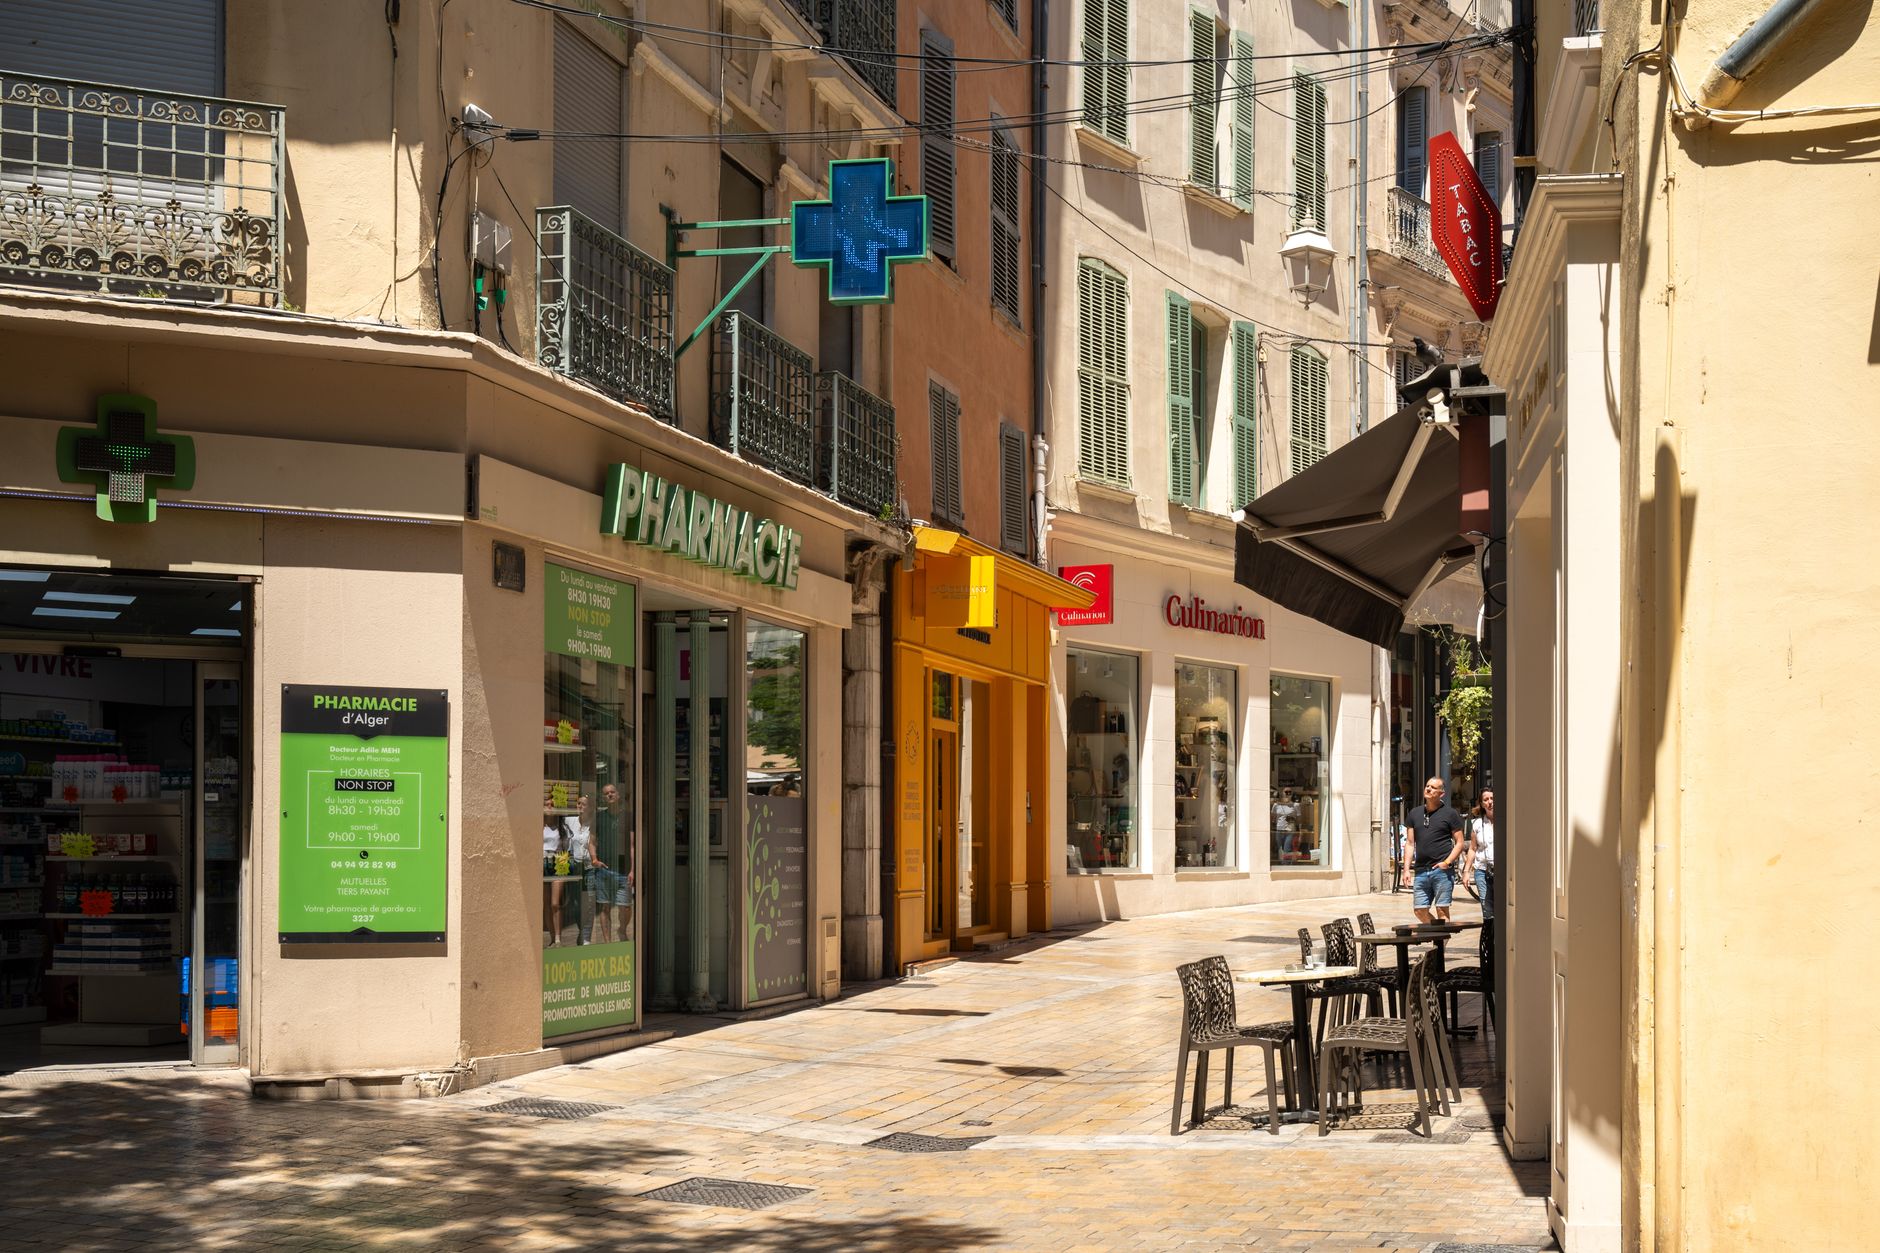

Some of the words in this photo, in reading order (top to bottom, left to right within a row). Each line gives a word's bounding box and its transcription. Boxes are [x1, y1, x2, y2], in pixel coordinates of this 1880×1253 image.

[1448, 183, 1482, 267] TABAC
[601, 462, 804, 591] PHARMACIE
[560, 570, 569, 584] Du
[570, 572, 585, 587] lundi
[585, 580, 594, 590] au
[594, 582, 618, 595] vendredi
[567, 587, 587, 604] 8H30
[589, 592, 611, 610] 19H30
[568, 605, 588, 623] NON
[590, 609, 611, 628] STOP
[1060, 609, 1106, 621] Culinarion
[1166, 594, 1266, 640] Culinarion
[576, 624, 582, 637] le
[583, 629, 603, 642] samedi
[567, 638, 612, 660] 9H00-19H00
[14, 655, 93, 679] VIVRE
[313, 695, 418, 712] PHARMACIE
[342, 712, 390, 728] d'Alger
[330, 745, 358, 754] Docteur
[359, 746, 379, 754] Adile
[380, 747, 401, 755] MEHI
[366, 755, 400, 763] Pharmacie
[340, 768, 390, 778] HORAIRES
[337, 780, 364, 790] NON
[366, 781, 393, 790] STOP
[325, 796, 335, 804] du
[337, 796, 357, 804] lundi
[371, 796, 404, 806] vendredi
[328, 805, 356, 816] 8h30
[367, 805, 401, 816] 19h30
[350, 823, 379, 831] samedi
[328, 831, 356, 842] 9h00
[367, 832, 400, 842] 19h00
[331, 861, 343, 869] 04
[344, 861, 356, 869] 94
[358, 861, 370, 869] 92
[371, 861, 384, 869] 82
[385, 861, 397, 869] 98
[340, 877, 387, 886] MUTUELLES
[336, 887, 358, 896] TIERS
[360, 887, 390, 896] PAYANT
[304, 905, 325, 913] Votre
[326, 905, 368, 914] pharmacie
[369, 904, 380, 913] de
[381, 905, 404, 914] garde
[351, 915, 375, 923] 3237
[544, 960, 577, 985] 100%
[580, 957, 607, 981] PRIX
[609, 954, 631, 977] BAS
[543, 987, 576, 1004] PROFITEZ
[580, 986, 590, 999] DE
[594, 980, 631, 997] NOUVELLES
[543, 1004, 587, 1023] PROMOTIONS
[587, 1001, 605, 1016] TOUS
[605, 999, 616, 1013] LES
[615, 997, 632, 1010] MOIS
